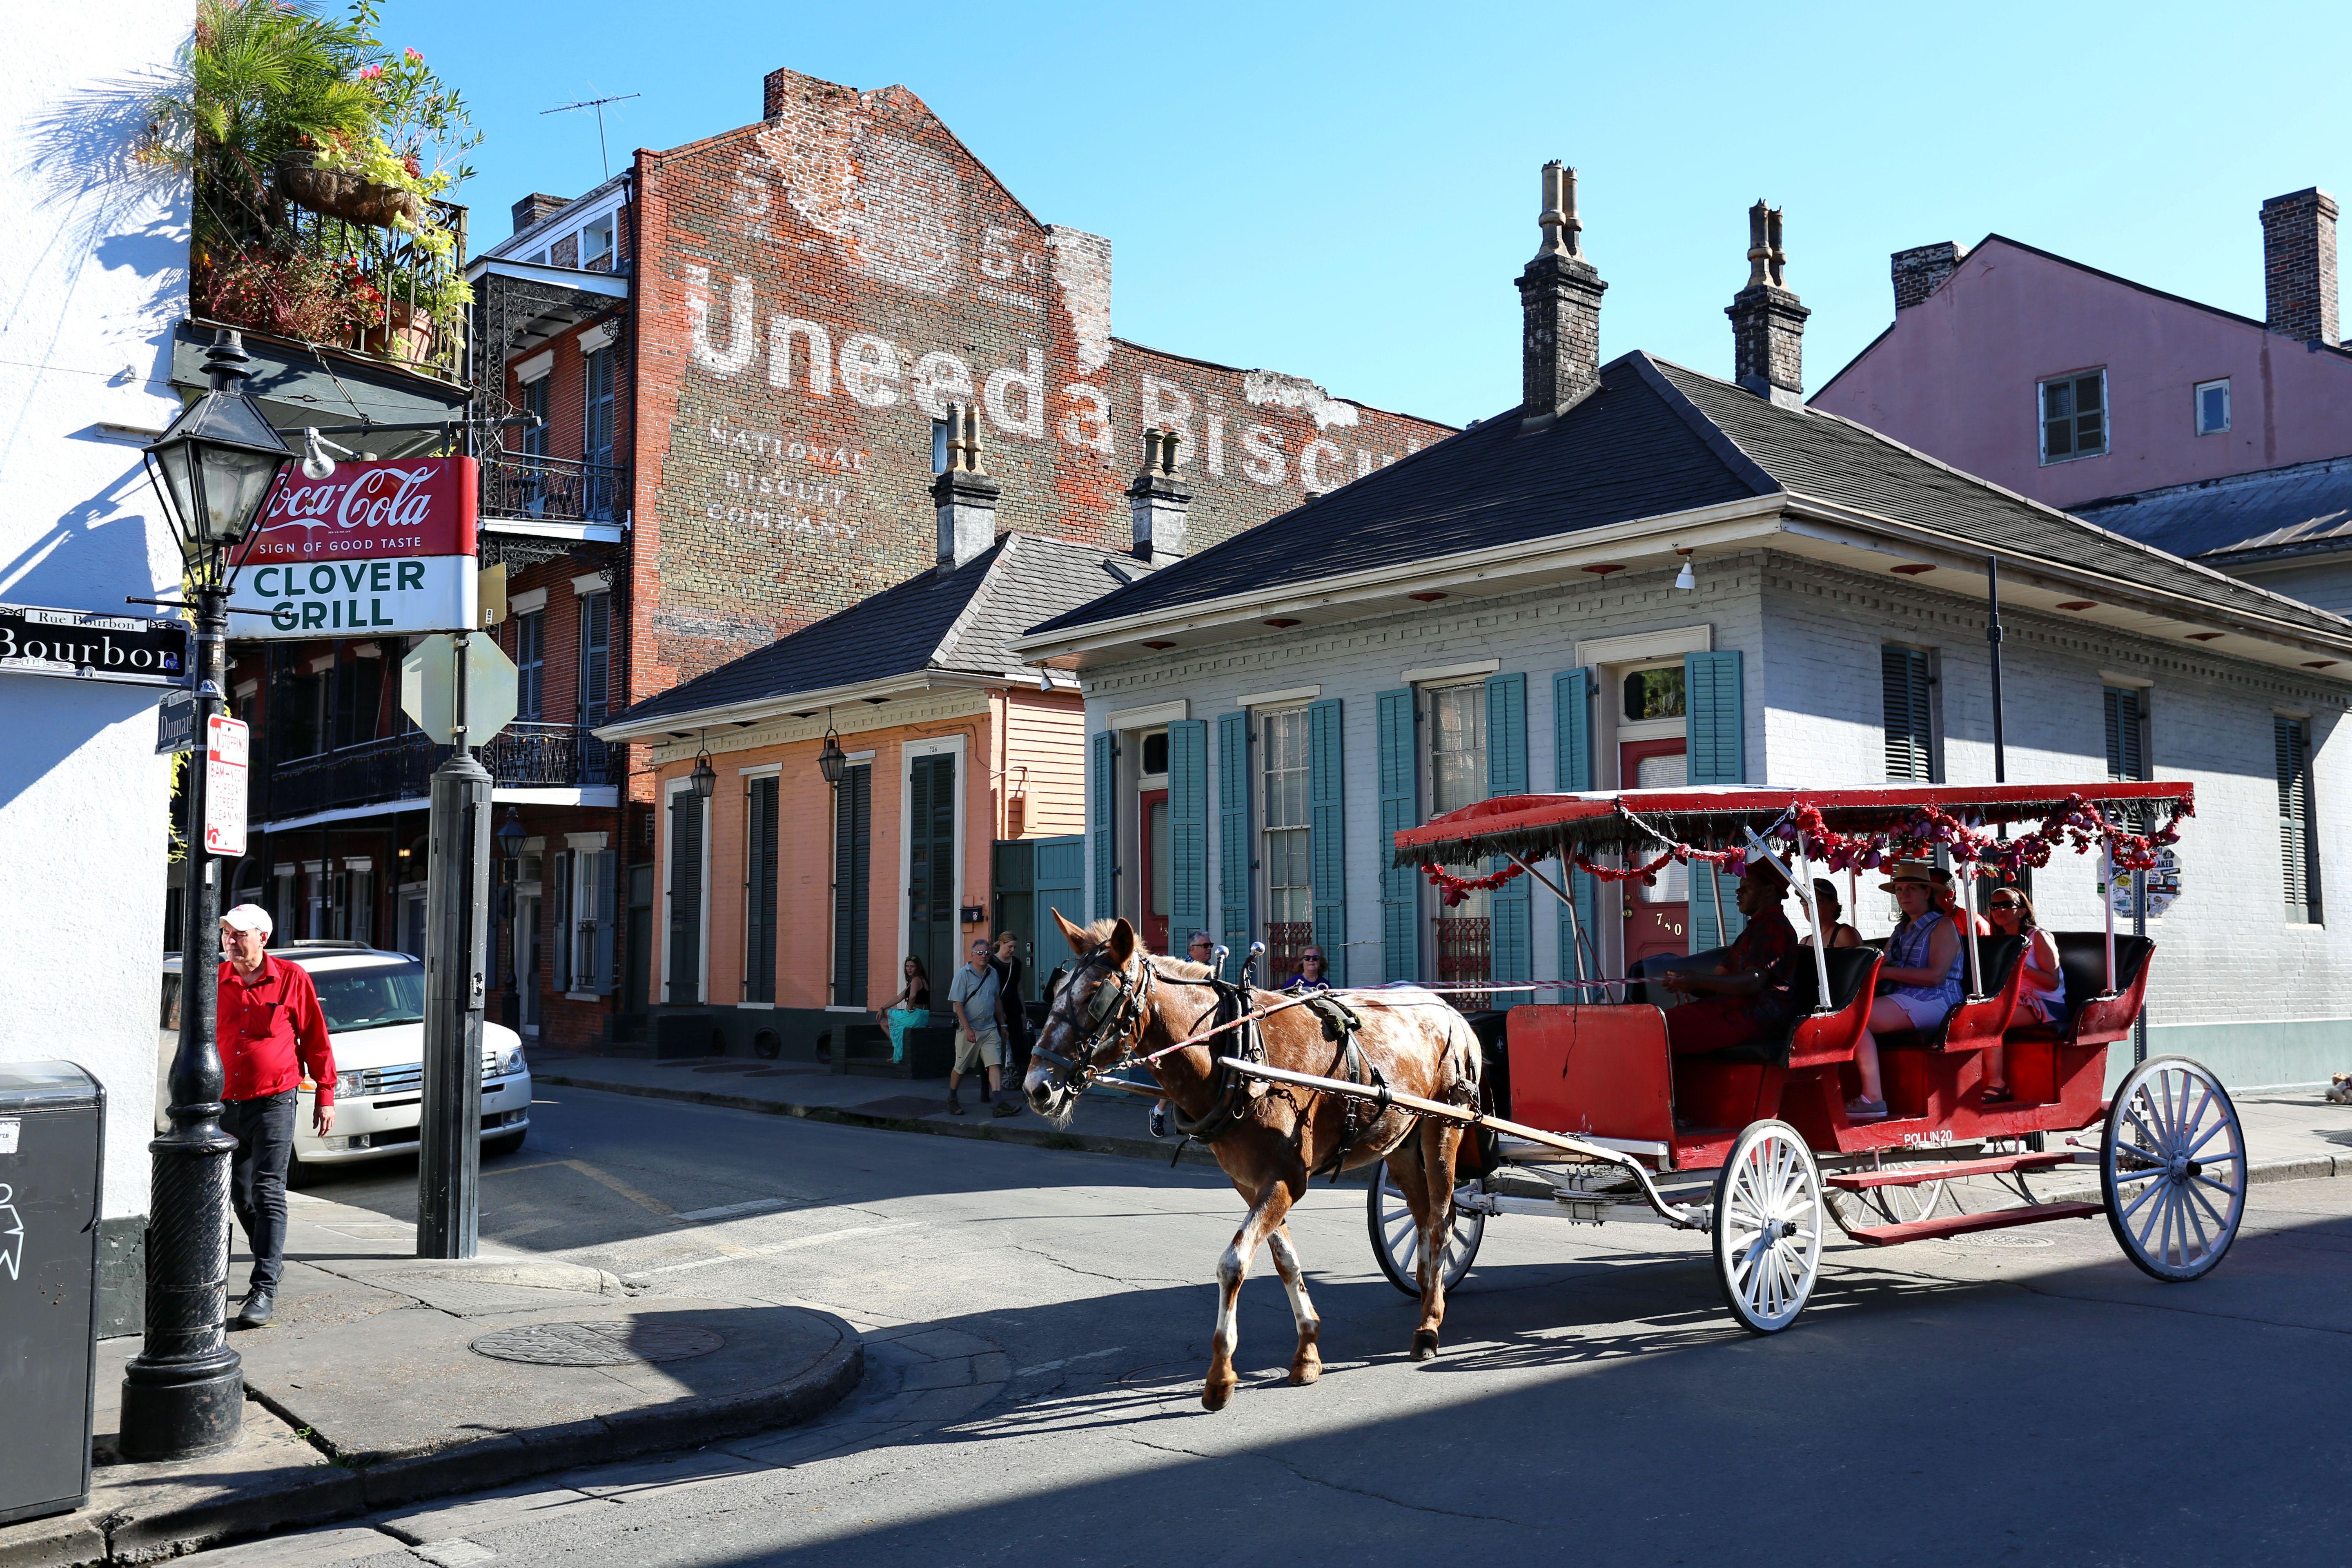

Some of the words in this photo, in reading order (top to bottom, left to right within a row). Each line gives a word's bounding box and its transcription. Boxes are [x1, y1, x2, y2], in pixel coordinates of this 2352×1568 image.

[710, 419, 868, 470] NATIONAL
[724, 470, 847, 506] BISCUIT
[707, 503, 861, 537] COMPANY
[260, 542, 294, 554] SIGN
[303, 541, 322, 552] OF
[330, 540, 373, 550] GOOD
[381, 537, 421, 548] TASTE
[254, 561, 425, 597] CLOVER
[39, 612, 66, 624] Rue
[73, 615, 135, 630] Bourbon
[271, 599, 393, 631] GRILL
[209, 726, 221, 752] NO
[221, 733, 245, 753] STOPPING
[215, 795, 238, 809] STREET
[210, 808, 243, 823] CLEANING
[2155, 860, 2174, 868] AKED
[1656, 913, 1682, 936] 740
[1904, 1130, 1940, 1145] POLLIN
[1940, 1129, 1952, 1142] 20
